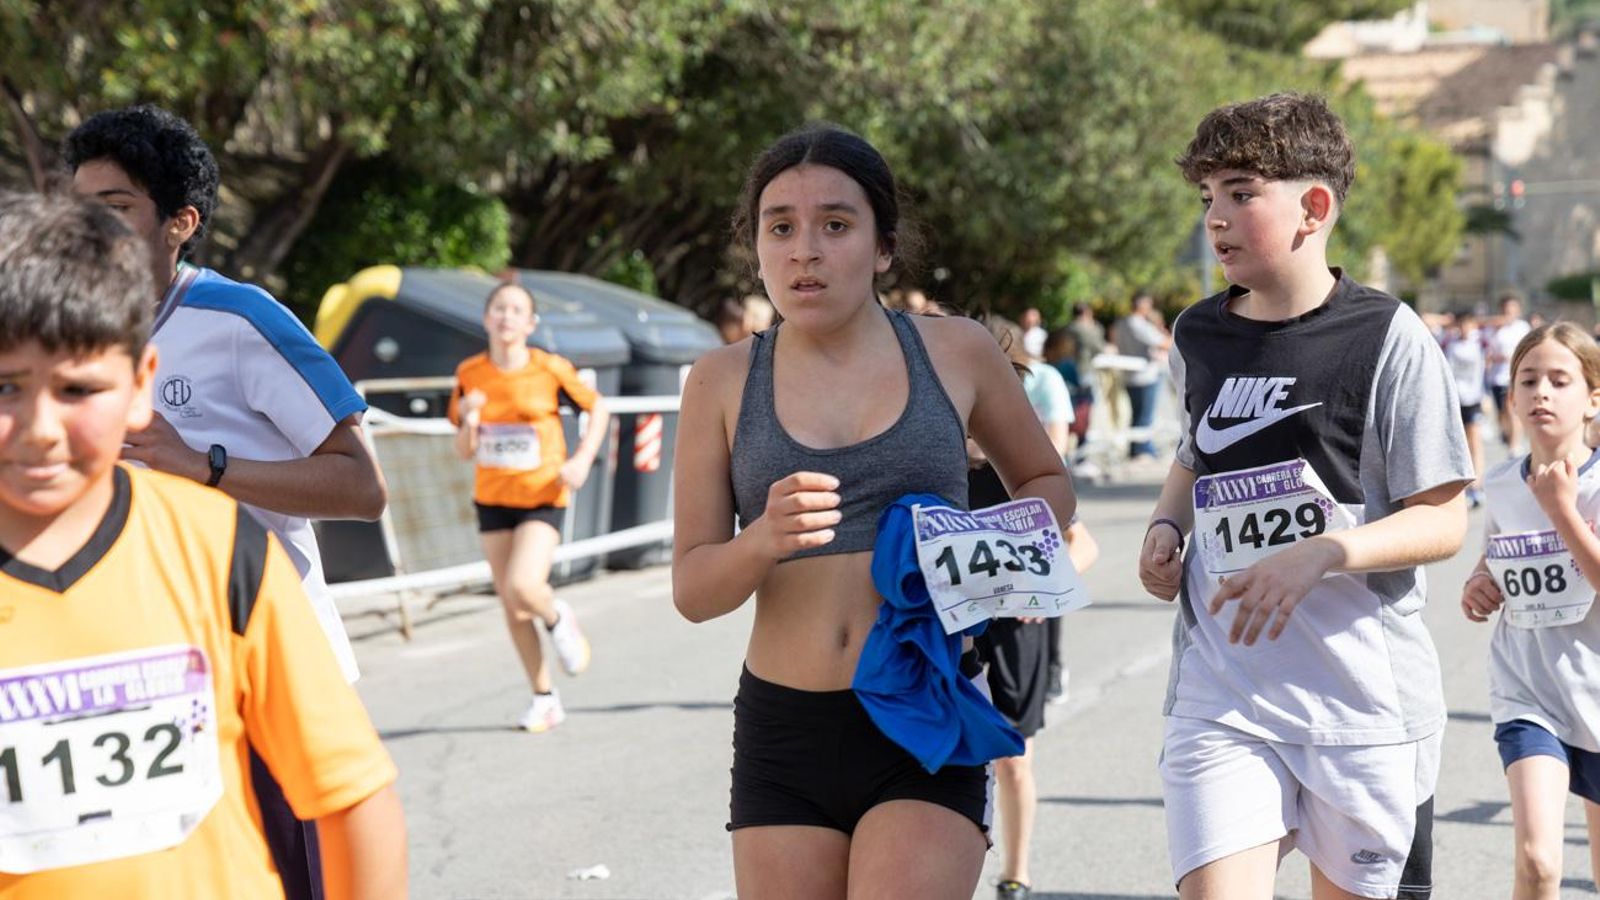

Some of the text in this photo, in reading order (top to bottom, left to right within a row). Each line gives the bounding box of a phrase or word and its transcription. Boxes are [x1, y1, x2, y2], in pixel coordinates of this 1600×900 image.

[1209, 377, 1297, 418] NIKE
[1255, 470, 1291, 484] CARRERA
[1264, 481, 1277, 494] LA
[1003, 504, 1042, 521] ESCOLAR
[1215, 502, 1326, 553] 1429
[935, 539, 1051, 586] 1433
[1503, 563, 1567, 598] 608
[0, 723, 184, 803] 1132
